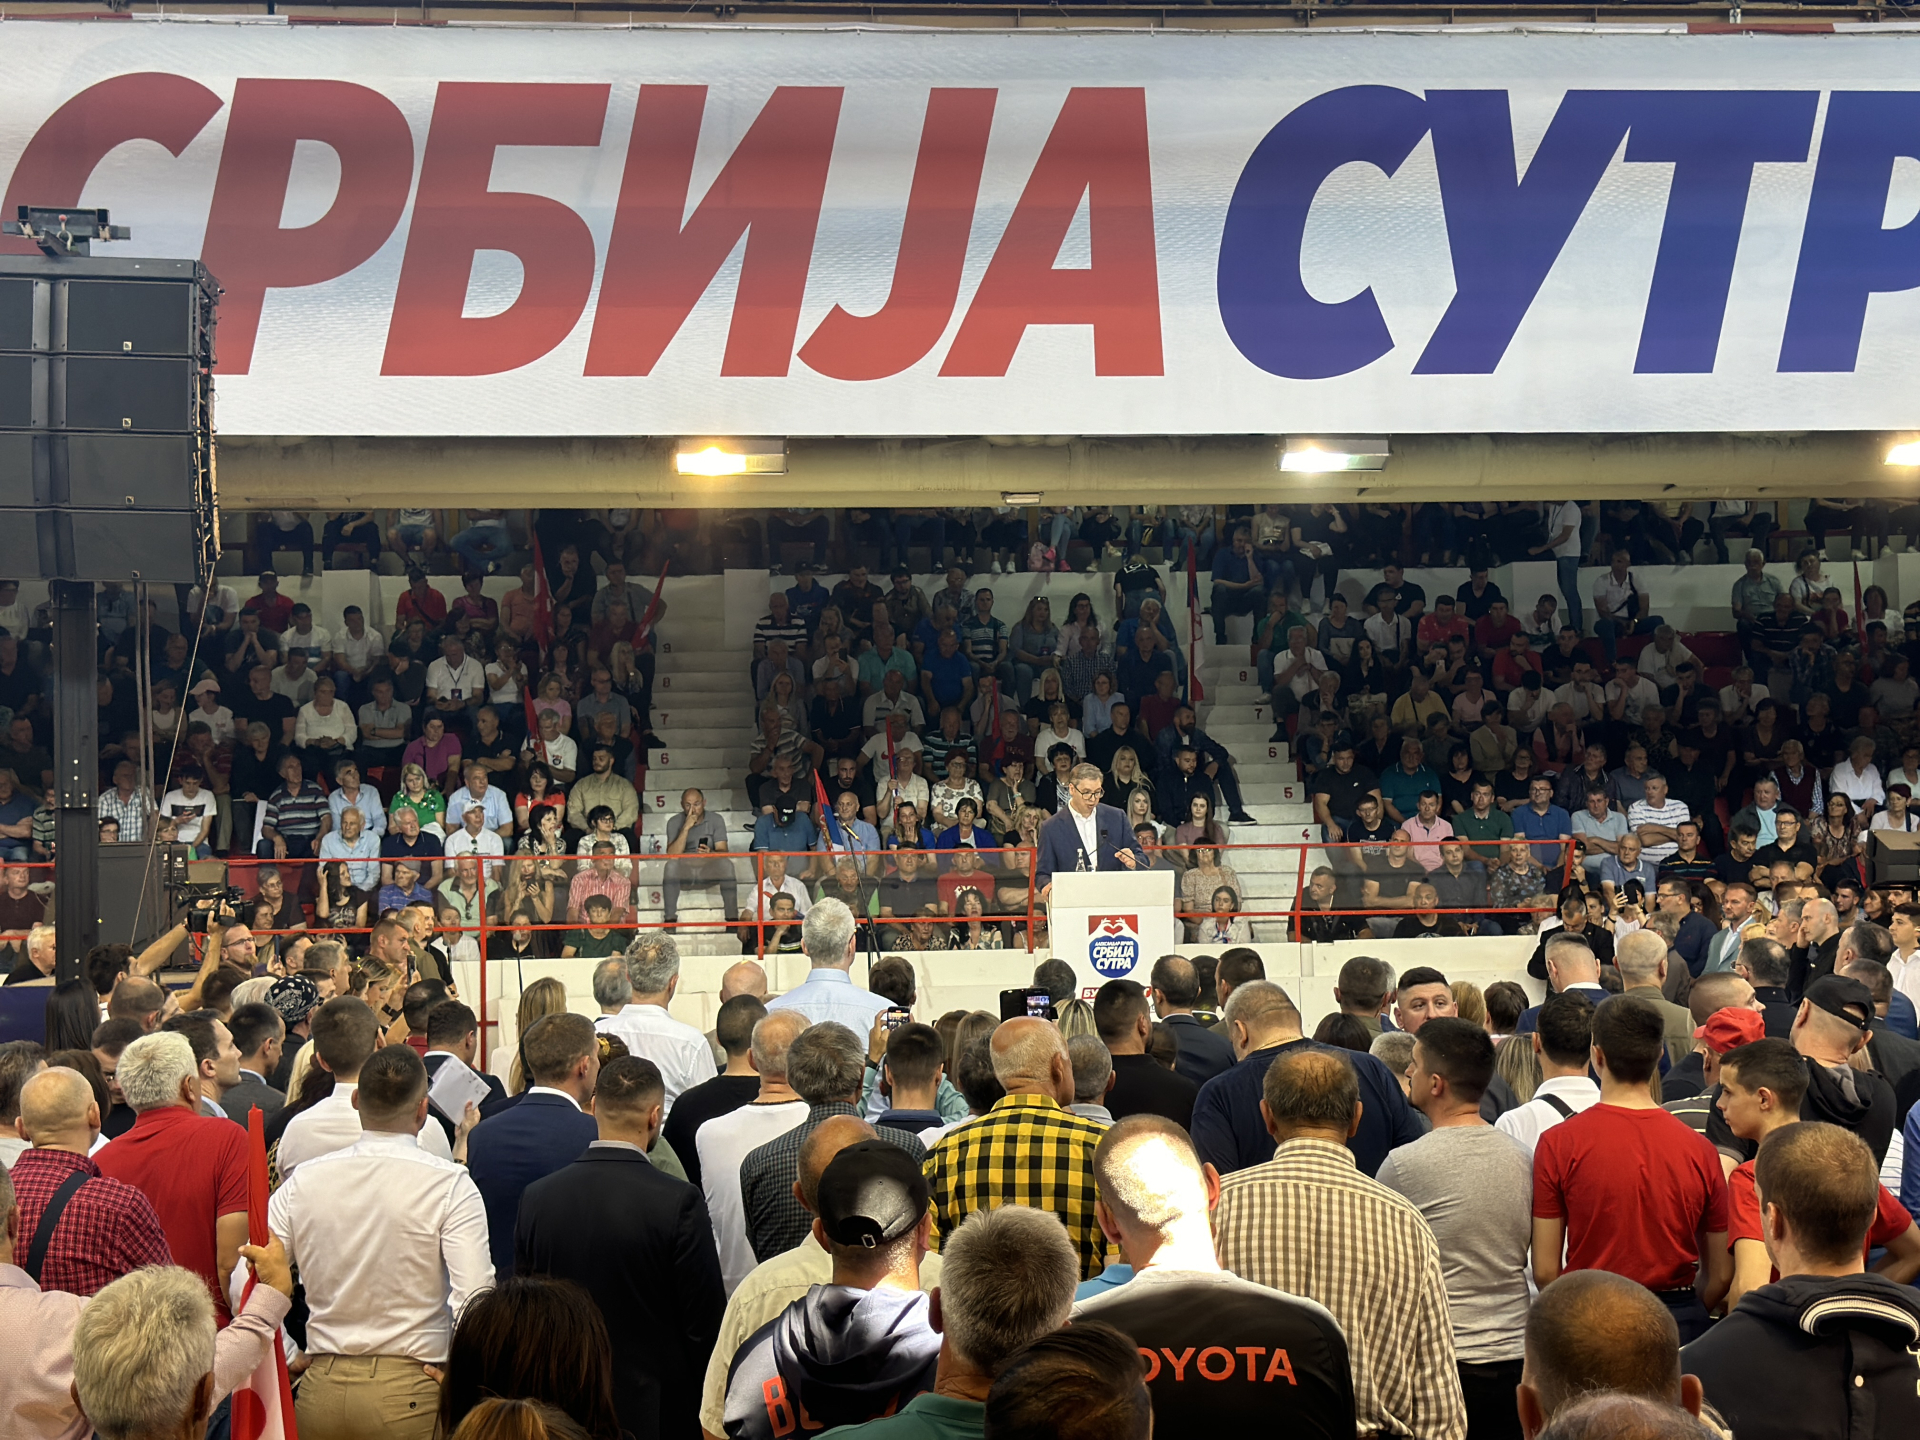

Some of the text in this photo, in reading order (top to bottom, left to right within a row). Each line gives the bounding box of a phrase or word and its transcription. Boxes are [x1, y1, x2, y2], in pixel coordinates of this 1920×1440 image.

[1217, 84, 1920, 380] СУТР
[662, 643, 671, 653] 9
[662, 677, 671, 688] 8
[1239, 671, 1247, 682] 8
[660, 713, 669, 725] 7
[1254, 708, 1262, 719] 7
[1268, 747, 1277, 758] 6
[660, 753, 669, 765] 6
[1283, 787, 1293, 799] 5
[656, 795, 665, 808] 5
[1301, 828, 1310, 840] 4
[651, 891, 661, 904] 3
[1093, 946, 1135, 958] СРБИЈА
[1096, 957, 1132, 970] СУТРА
[1138, 1346, 1298, 1386] OYOTA
